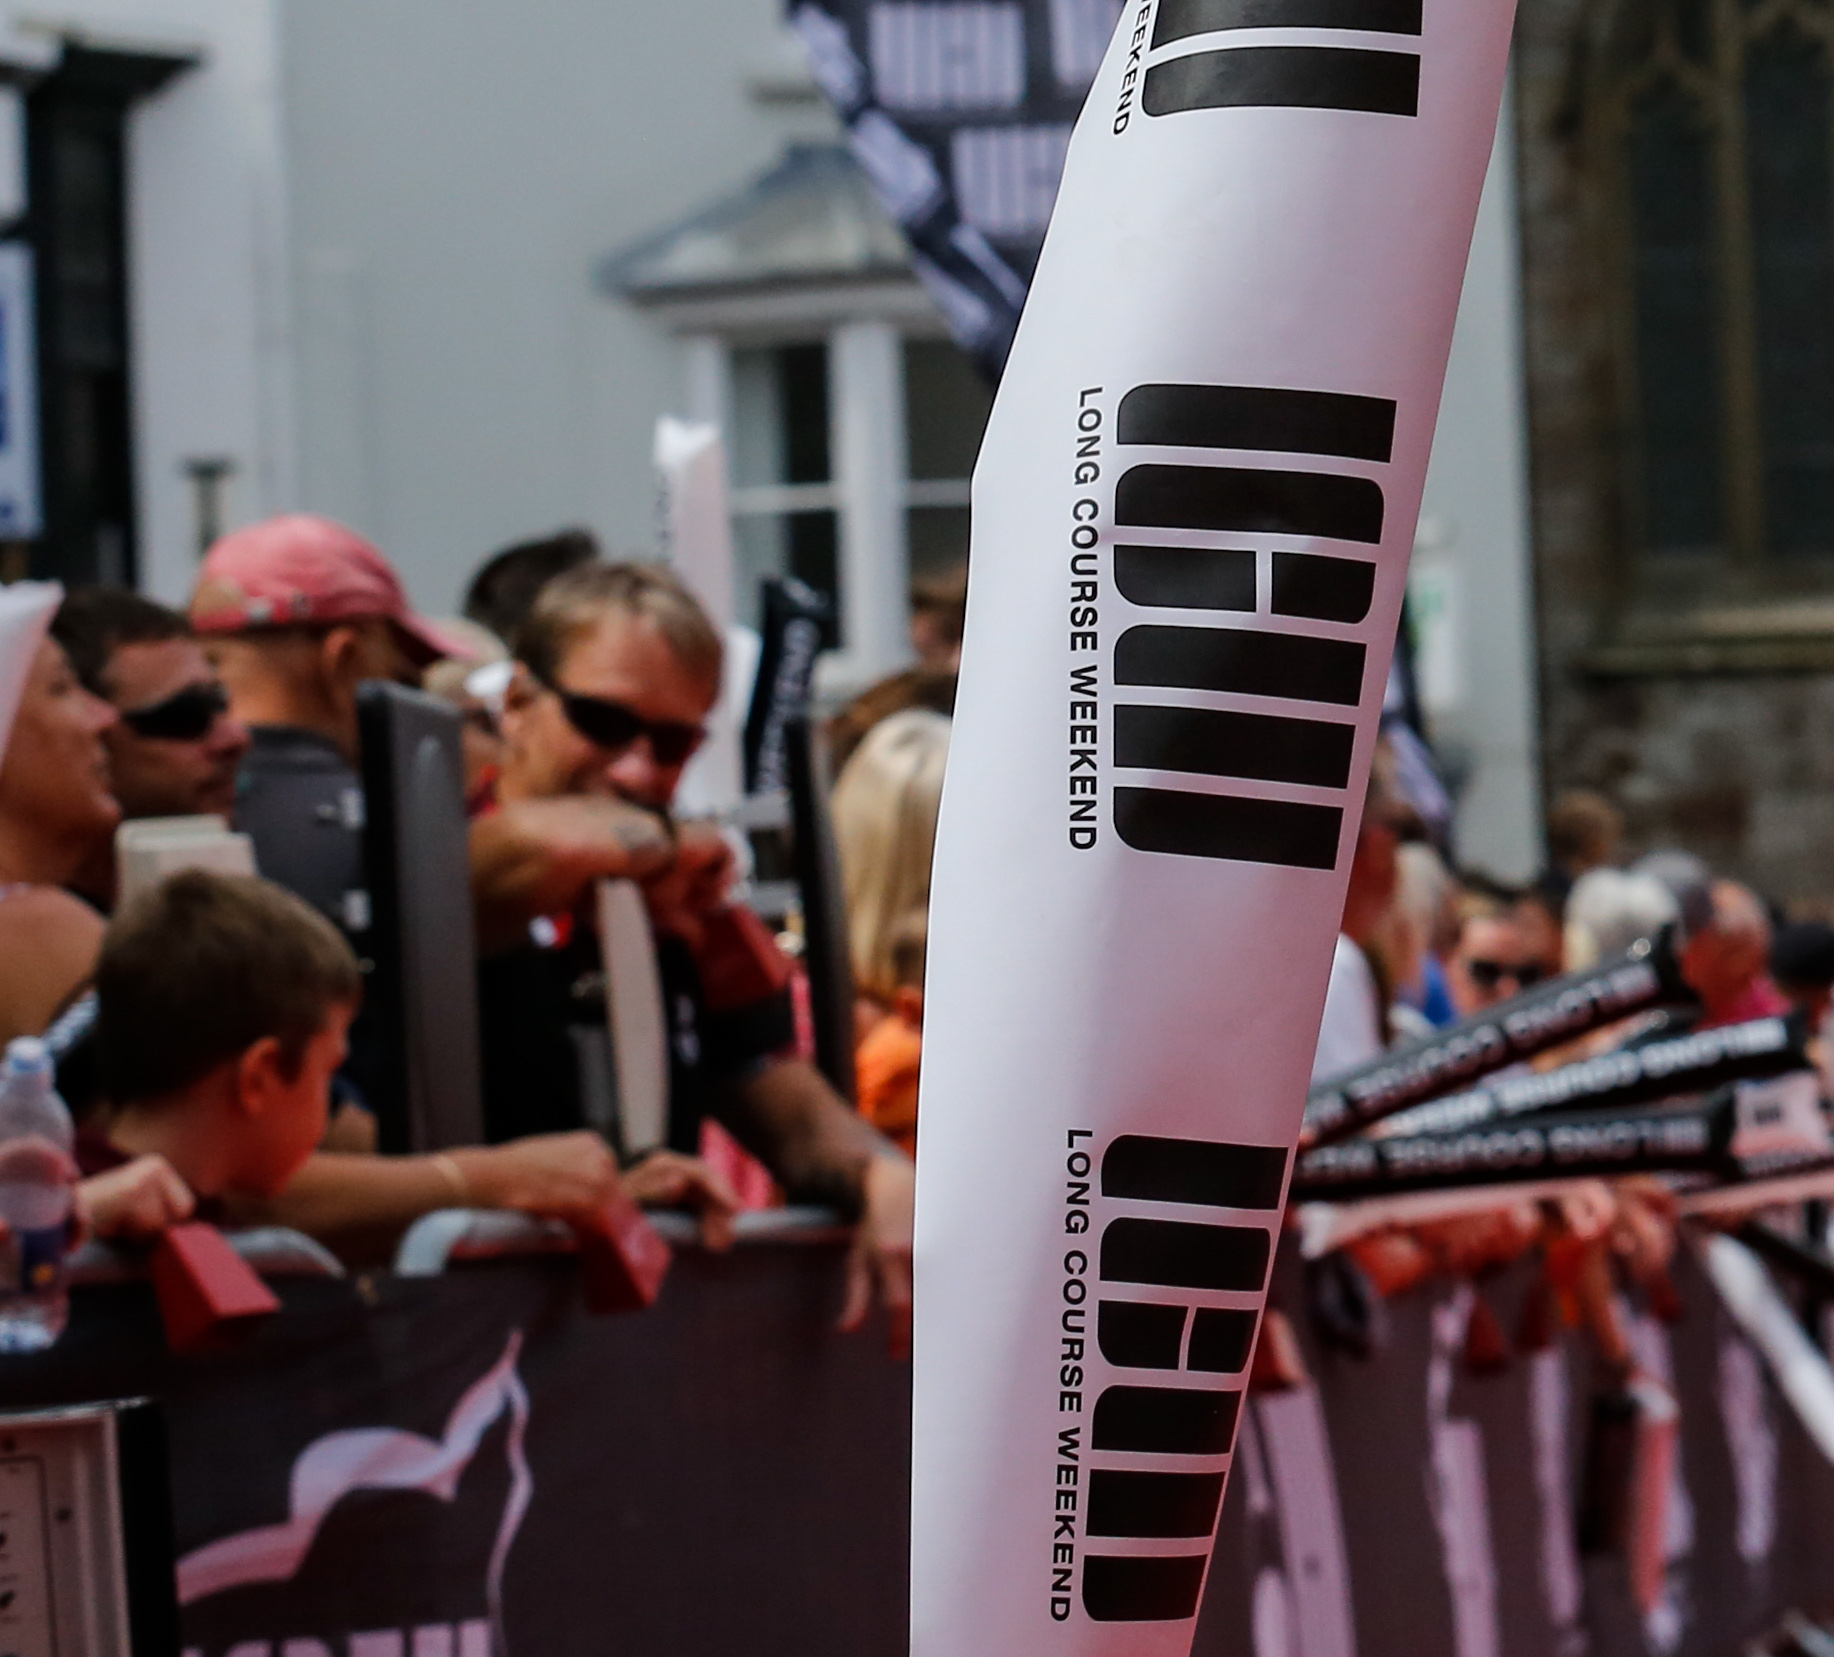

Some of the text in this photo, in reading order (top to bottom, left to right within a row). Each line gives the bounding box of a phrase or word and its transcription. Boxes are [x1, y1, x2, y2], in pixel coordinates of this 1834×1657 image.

[1067, 385, 1104, 852] LONG COURSE WEEKEND
[1049, 1128, 1093, 1623] LONG COURSE WEEKEND
